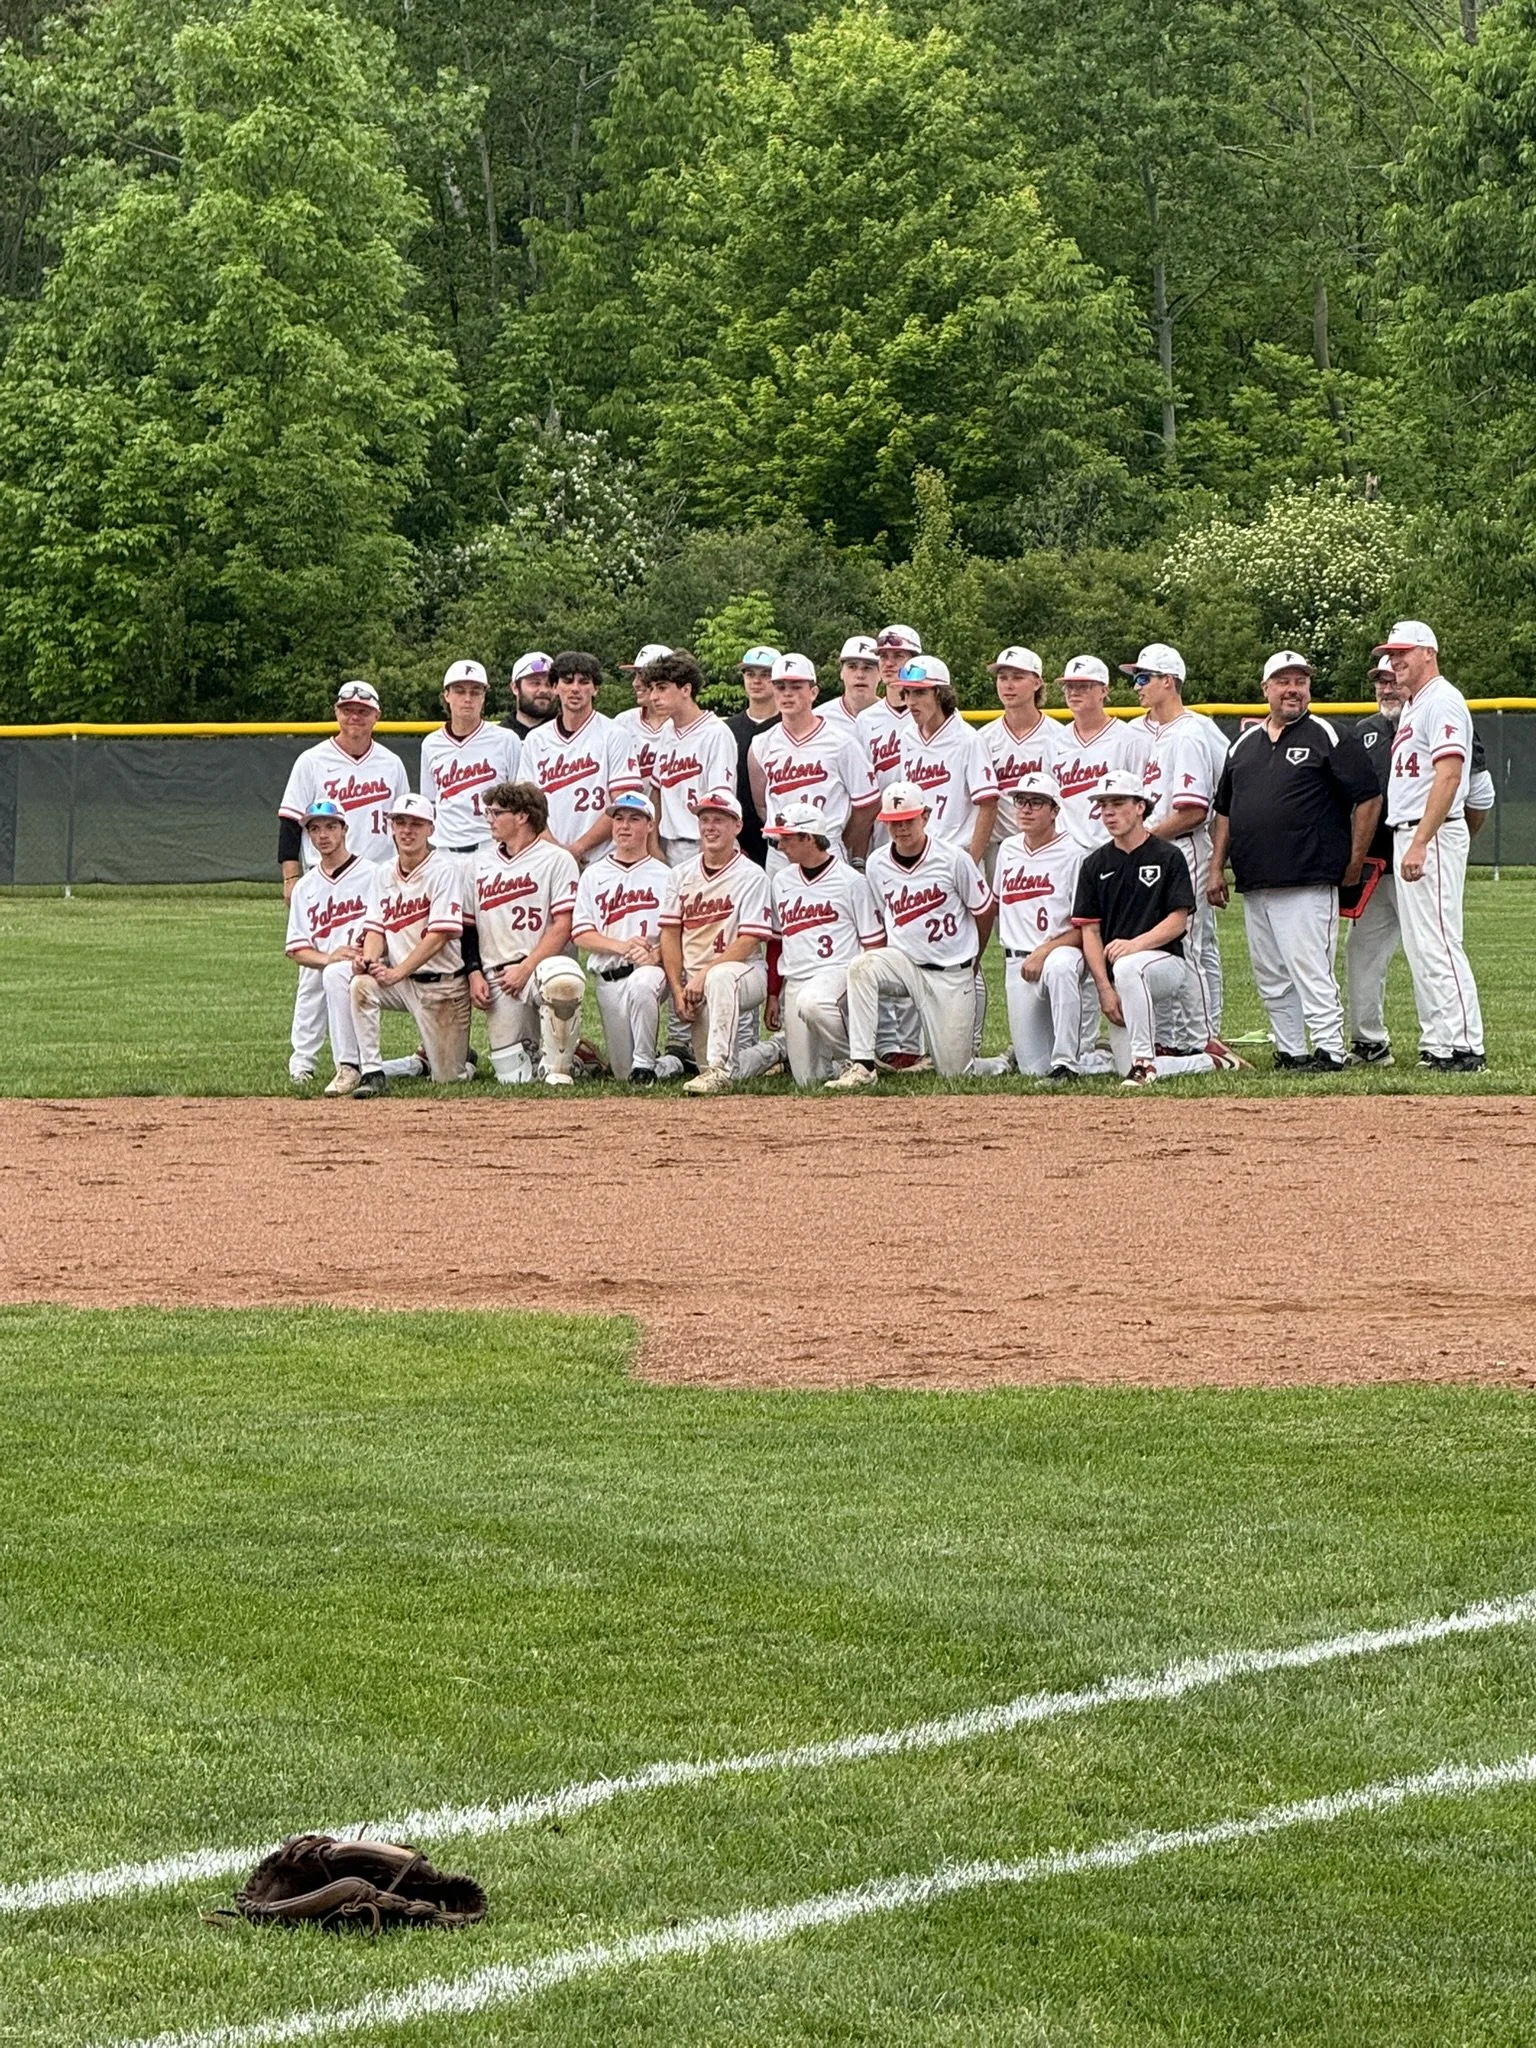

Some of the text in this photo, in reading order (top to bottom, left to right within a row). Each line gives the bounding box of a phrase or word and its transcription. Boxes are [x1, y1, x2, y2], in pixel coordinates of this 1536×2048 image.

[870, 730, 901, 765] Falc
[433, 758, 497, 790] Falcons
[537, 753, 600, 785] Falcons
[764, 756, 828, 785] Falcons
[904, 756, 951, 784] Falcons
[1053, 758, 1109, 788] Falcons
[1394, 751, 1420, 778] 44
[324, 775, 391, 801] Falcons
[574, 786, 605, 812] 23
[936, 795, 948, 820] 7
[477, 872, 538, 898] Falcons
[1002, 865, 1055, 890] Falcons
[595, 883, 659, 917] Falcons
[680, 892, 735, 919] Falcons
[884, 883, 947, 912] Falcons
[307, 895, 367, 932] Falcons
[511, 906, 543, 931] 25
[778, 896, 839, 927] Falcons
[1036, 907, 1048, 931] 6
[713, 929, 726, 953] 4
[817, 935, 834, 958] 3
